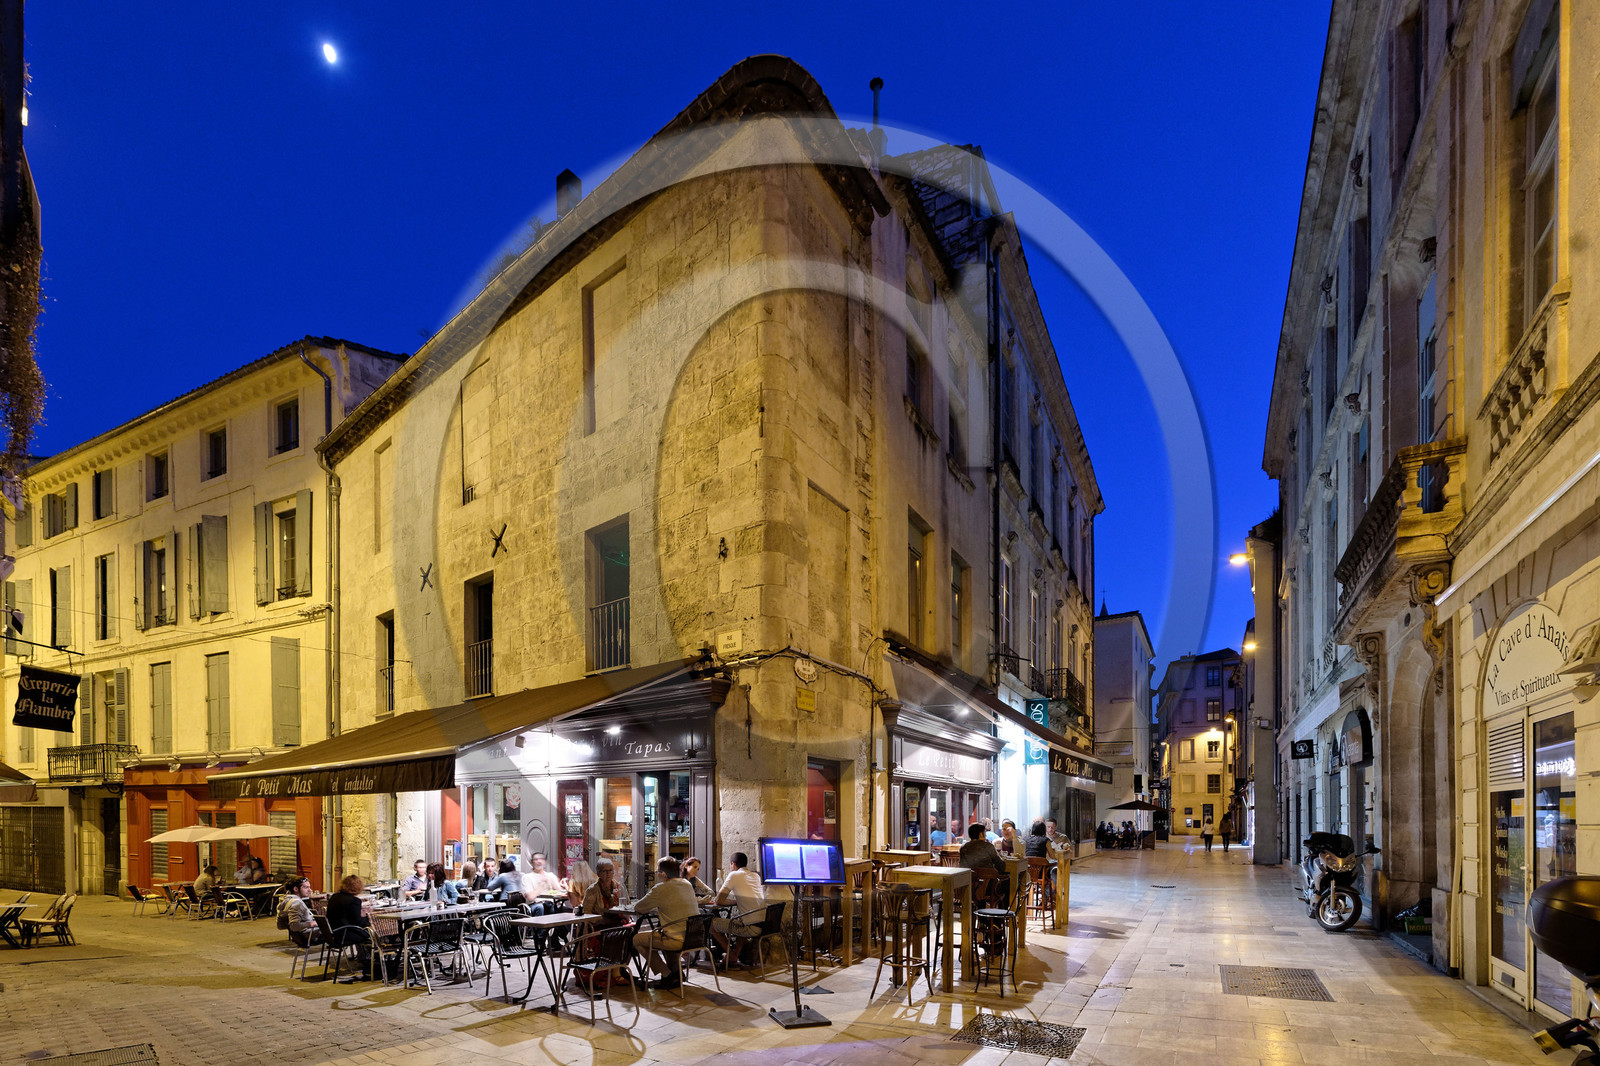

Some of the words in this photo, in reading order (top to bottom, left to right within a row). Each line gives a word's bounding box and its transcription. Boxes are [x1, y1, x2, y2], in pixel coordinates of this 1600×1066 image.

[1488, 664, 1499, 692] La
[1499, 628, 1522, 662] Cave
[20, 675, 76, 697] Creperie
[1495, 690, 1511, 706] Vins
[1512, 685, 1519, 700] et
[1520, 672, 1561, 702] Spiritueux
[42, 693, 53, 704] la
[624, 742, 672, 758] Tapas
[919, 752, 930, 767] Le
[934, 752, 955, 769] Petit
[1053, 754, 1062, 771] Le
[1065, 757, 1079, 775] Petit
[1082, 762, 1093, 778] Mas
[240, 781, 250, 797] Le
[257, 778, 281, 796] Petit
[287, 776, 313, 795] Mas
